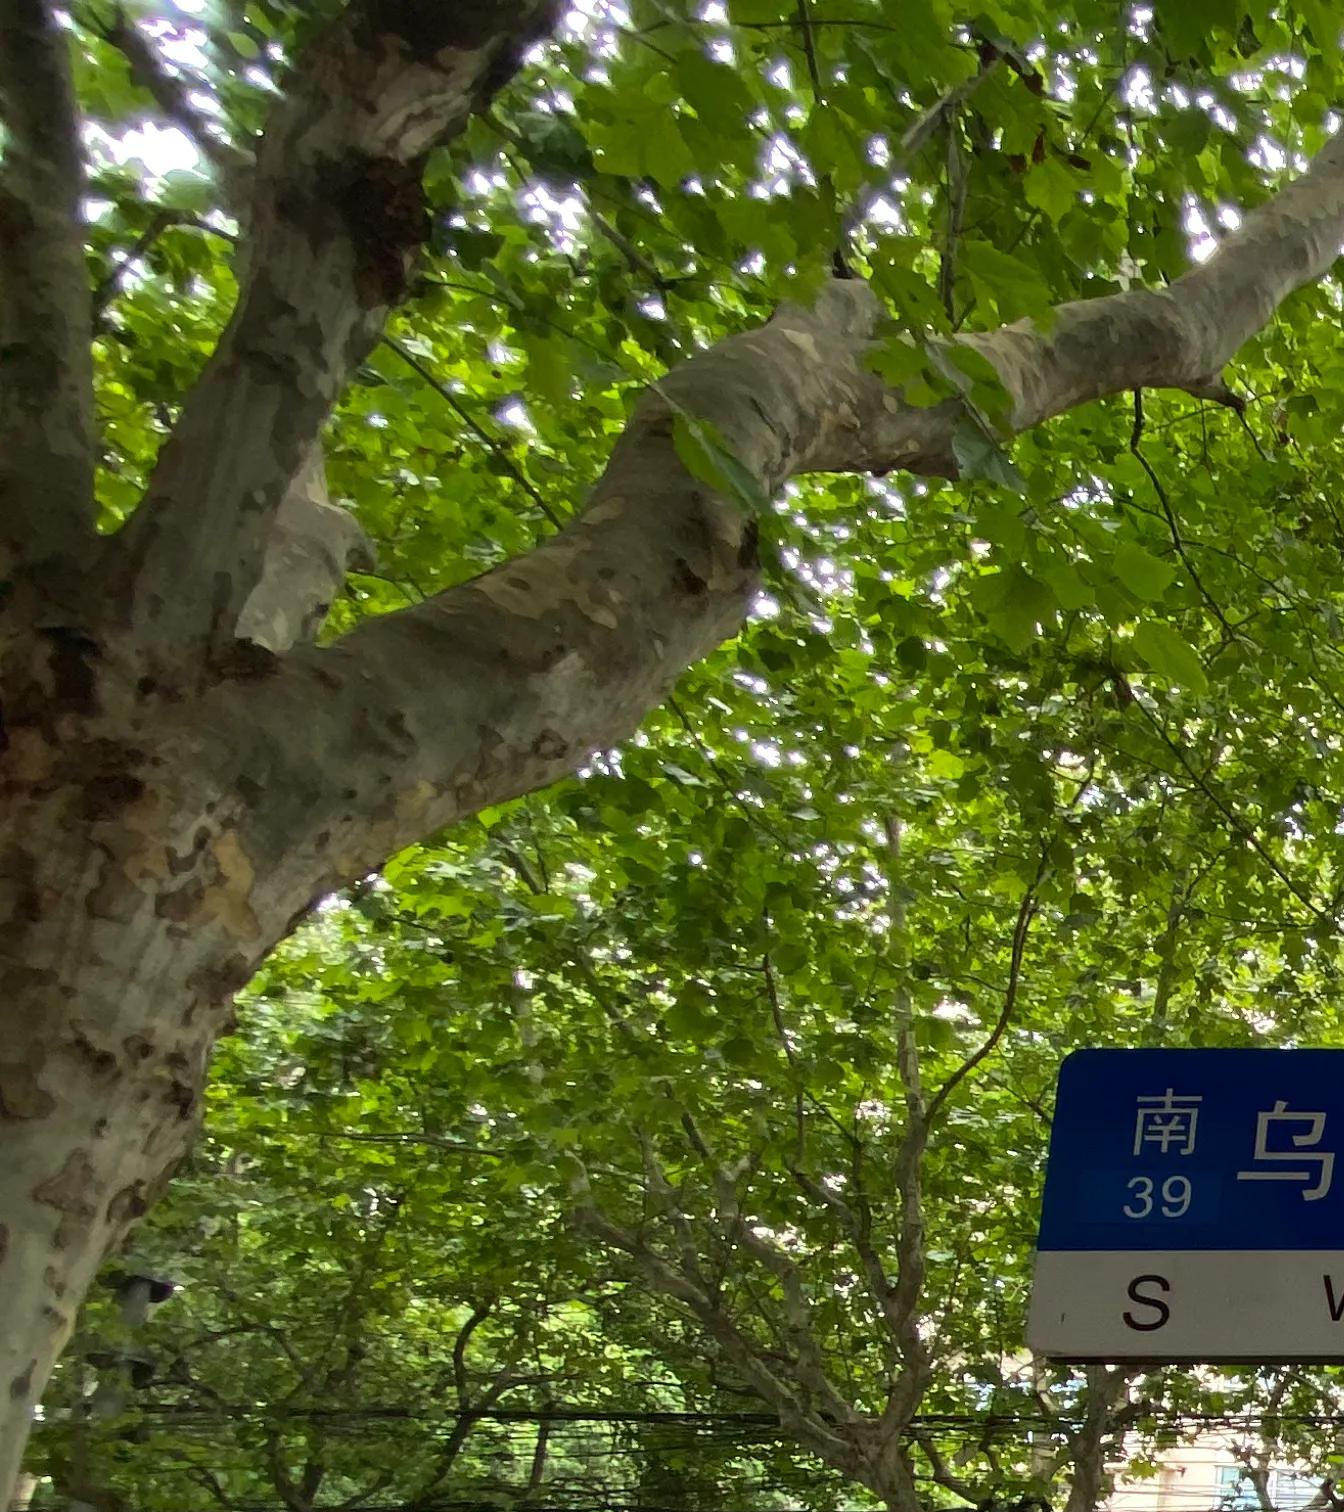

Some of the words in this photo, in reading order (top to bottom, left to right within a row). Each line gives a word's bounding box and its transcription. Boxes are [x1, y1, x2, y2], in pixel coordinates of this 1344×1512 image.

[1134, 1088, 1202, 1155] 南
[1124, 1176, 1191, 1218] 39
[1123, 1275, 1170, 1331] S
